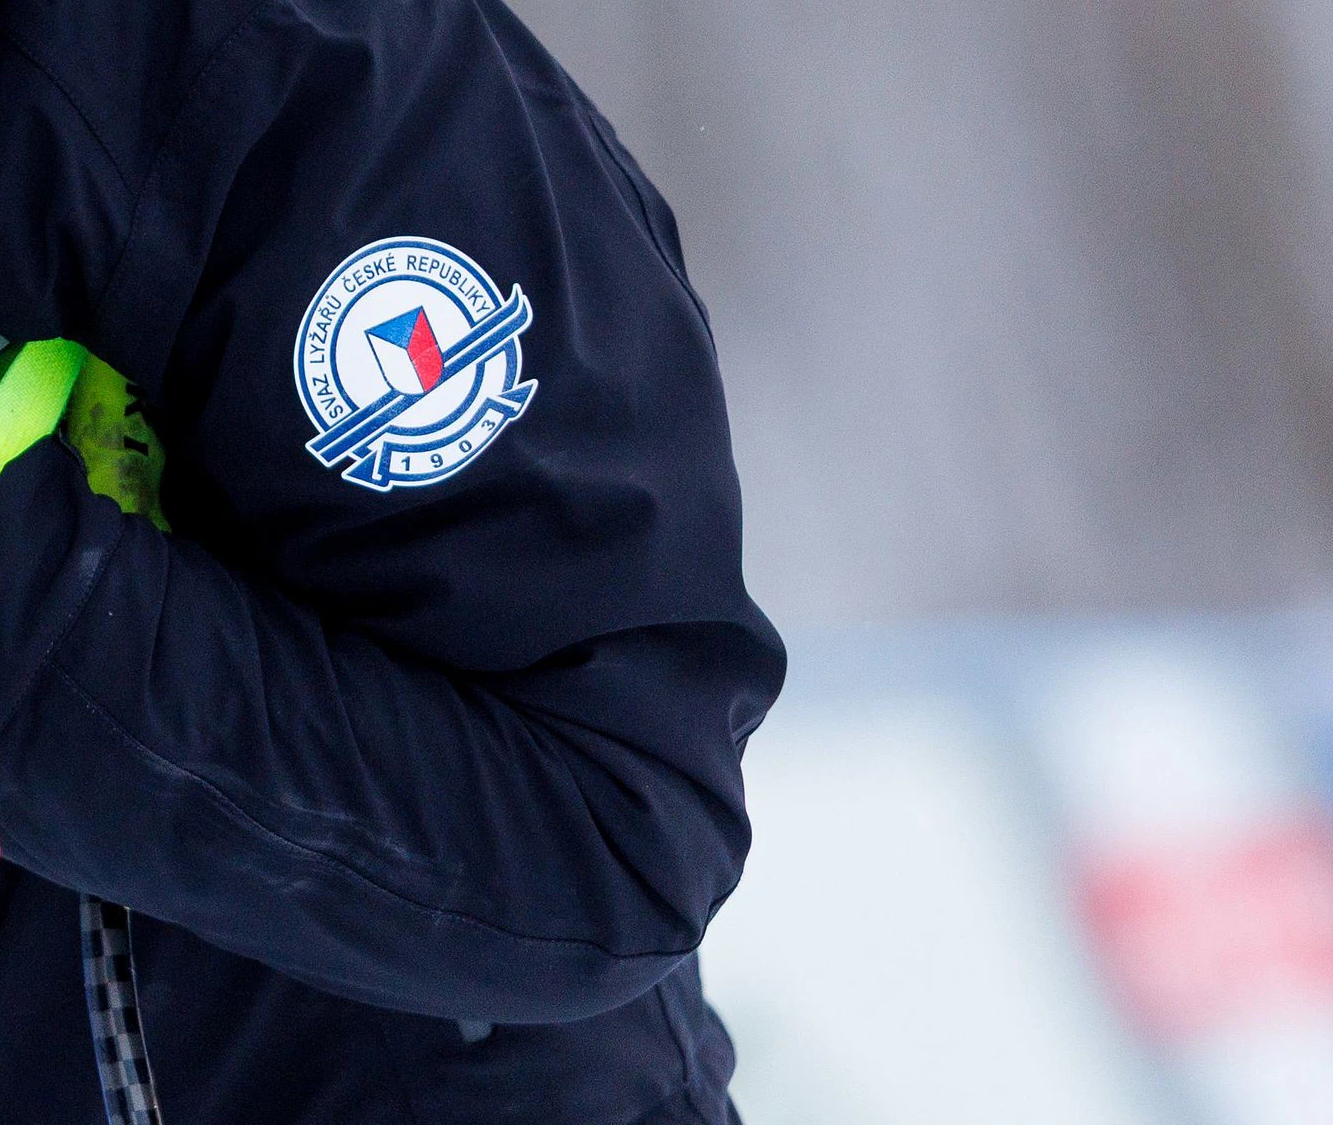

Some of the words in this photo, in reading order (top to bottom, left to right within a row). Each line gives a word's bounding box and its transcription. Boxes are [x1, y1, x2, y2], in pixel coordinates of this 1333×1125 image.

[312, 373, 345, 420] SVAZ
[341, 253, 397, 294] ČESKÉ
[406, 254, 491, 315] REPUBLIKY
[400, 419, 497, 472] 1903
